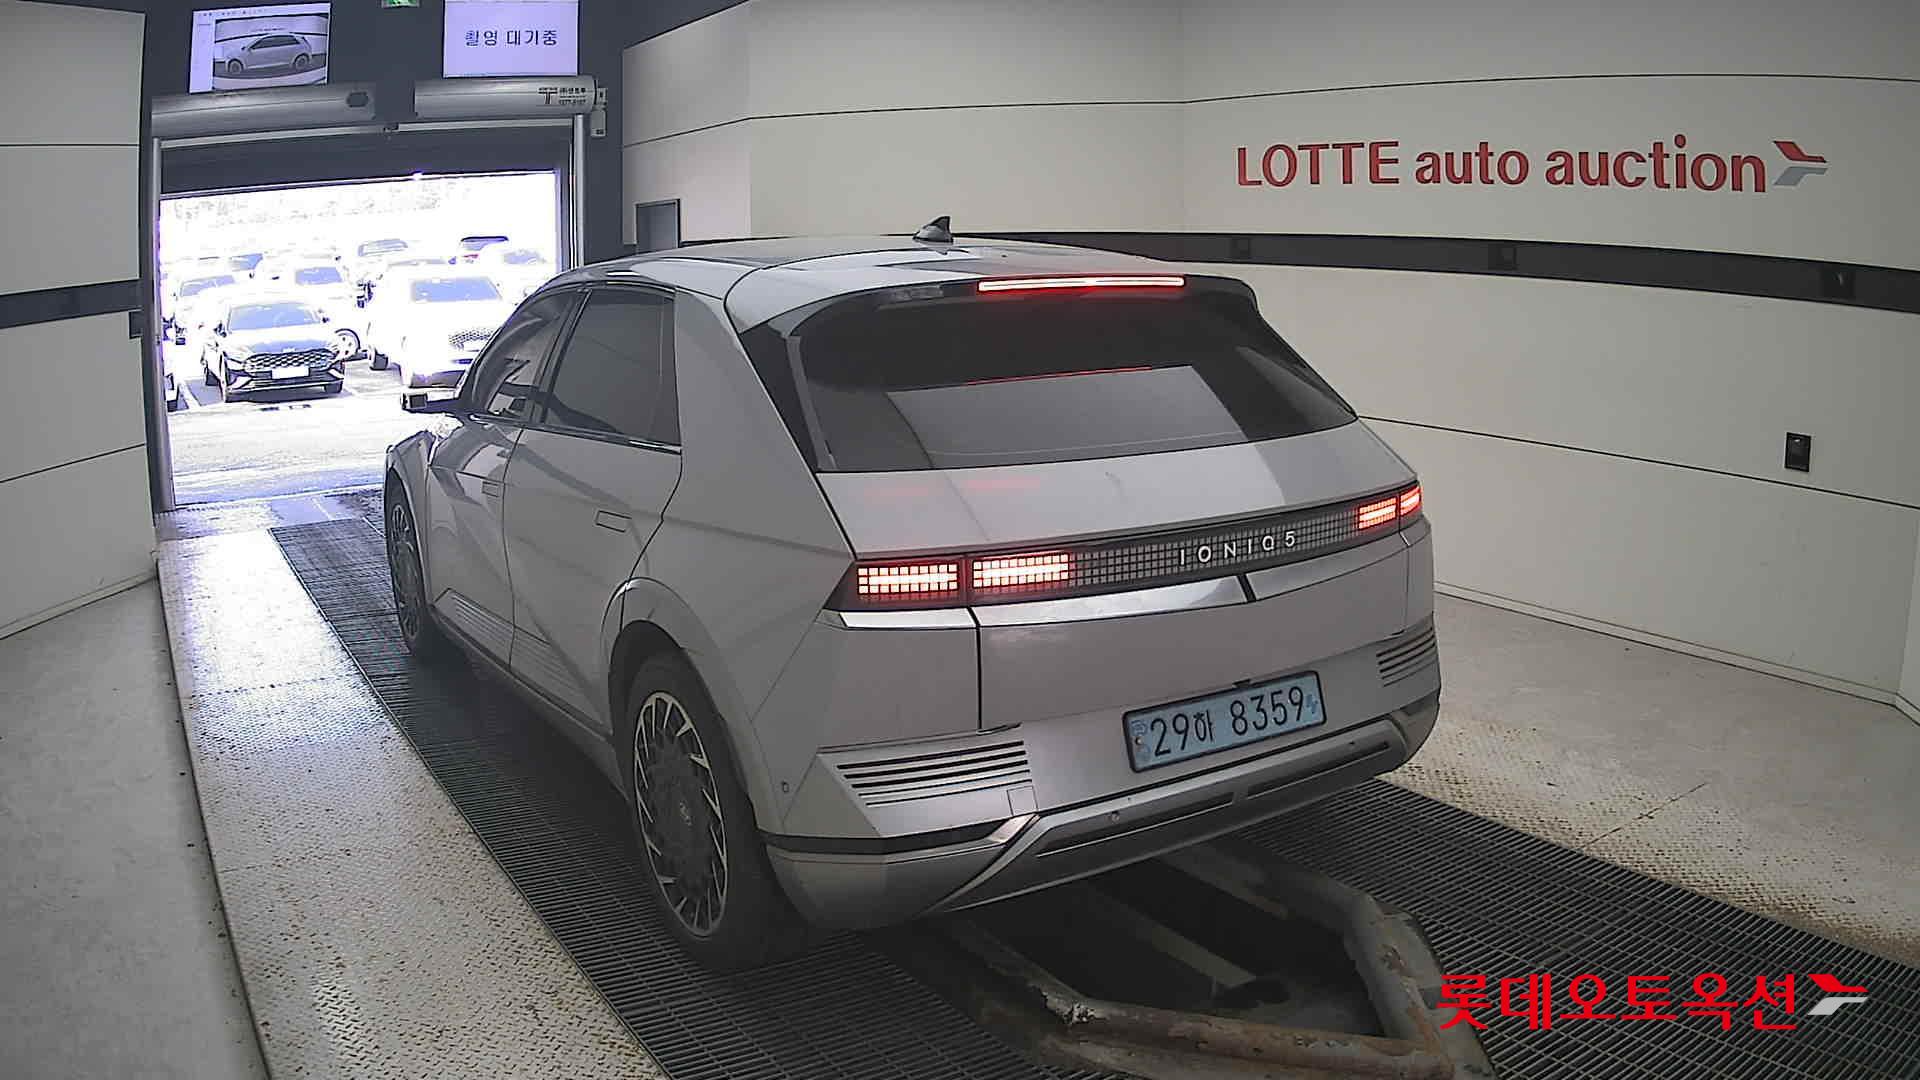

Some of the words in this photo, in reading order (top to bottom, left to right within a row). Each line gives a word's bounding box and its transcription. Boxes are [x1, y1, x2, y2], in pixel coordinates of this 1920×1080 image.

[506, 30, 558, 46] 대기중
[1236, 140, 1400, 187] LOTTE
[1415, 140, 1529, 187] auto
[1544, 133, 1767, 193] auction
[1150, 709, 1215, 757] 29하
[1229, 686, 1305, 736] 8359
